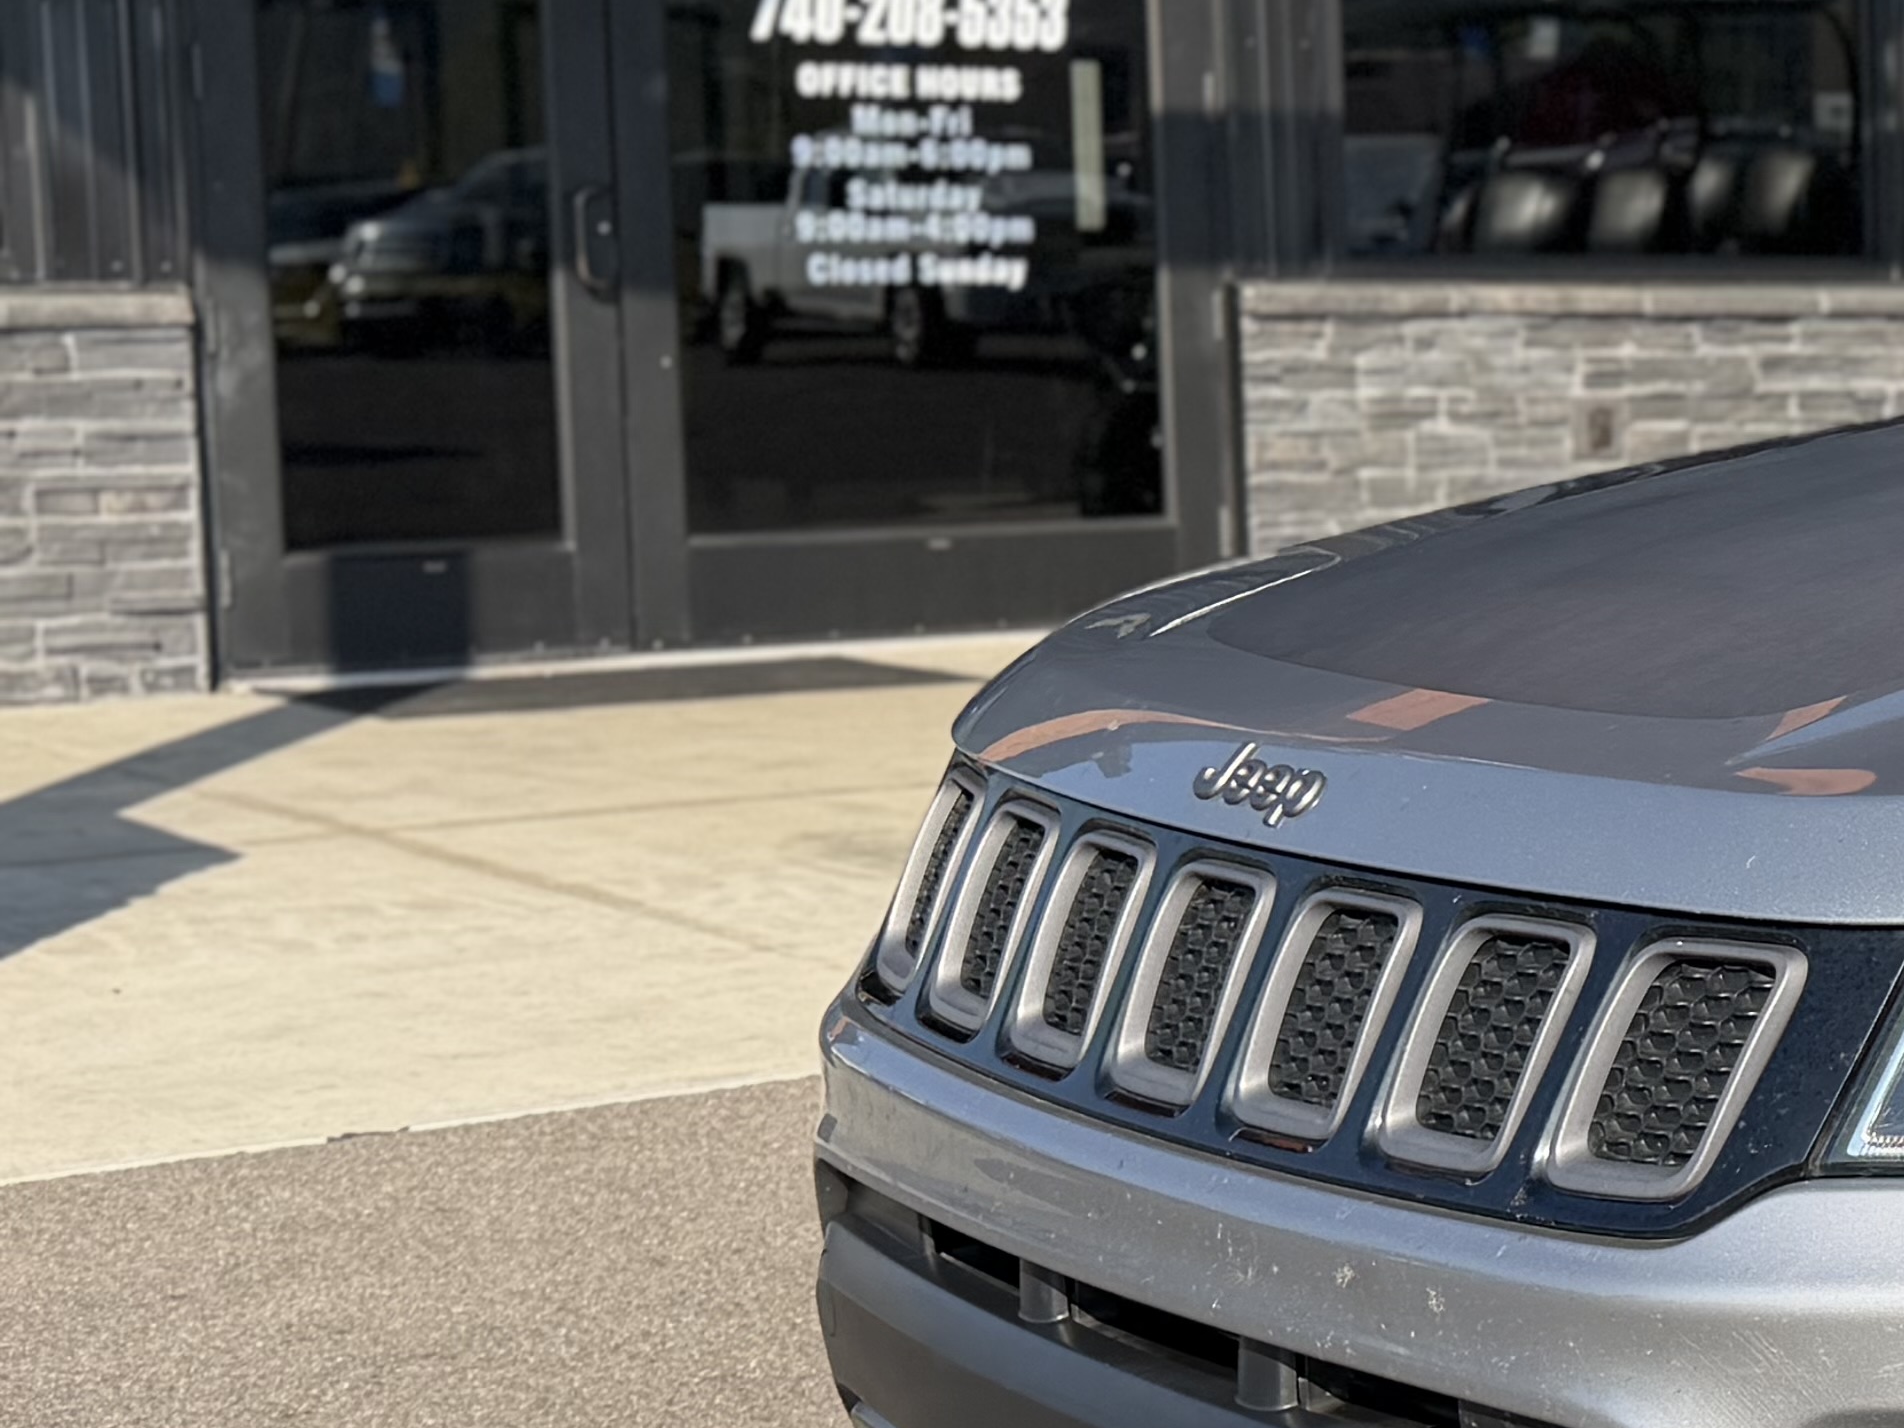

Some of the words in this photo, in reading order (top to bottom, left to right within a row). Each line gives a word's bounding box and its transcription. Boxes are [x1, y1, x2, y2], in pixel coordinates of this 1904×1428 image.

[795, 61, 911, 99] OFFICE
[915, 65, 1022, 103] HOURS
[851, 104, 973, 138] Mon-Fri
[846, 176, 984, 212] Saturday
[806, 251, 912, 287] Closed
[917, 252, 1029, 292] Sunday
[1192, 740, 1328, 828] Jeep
